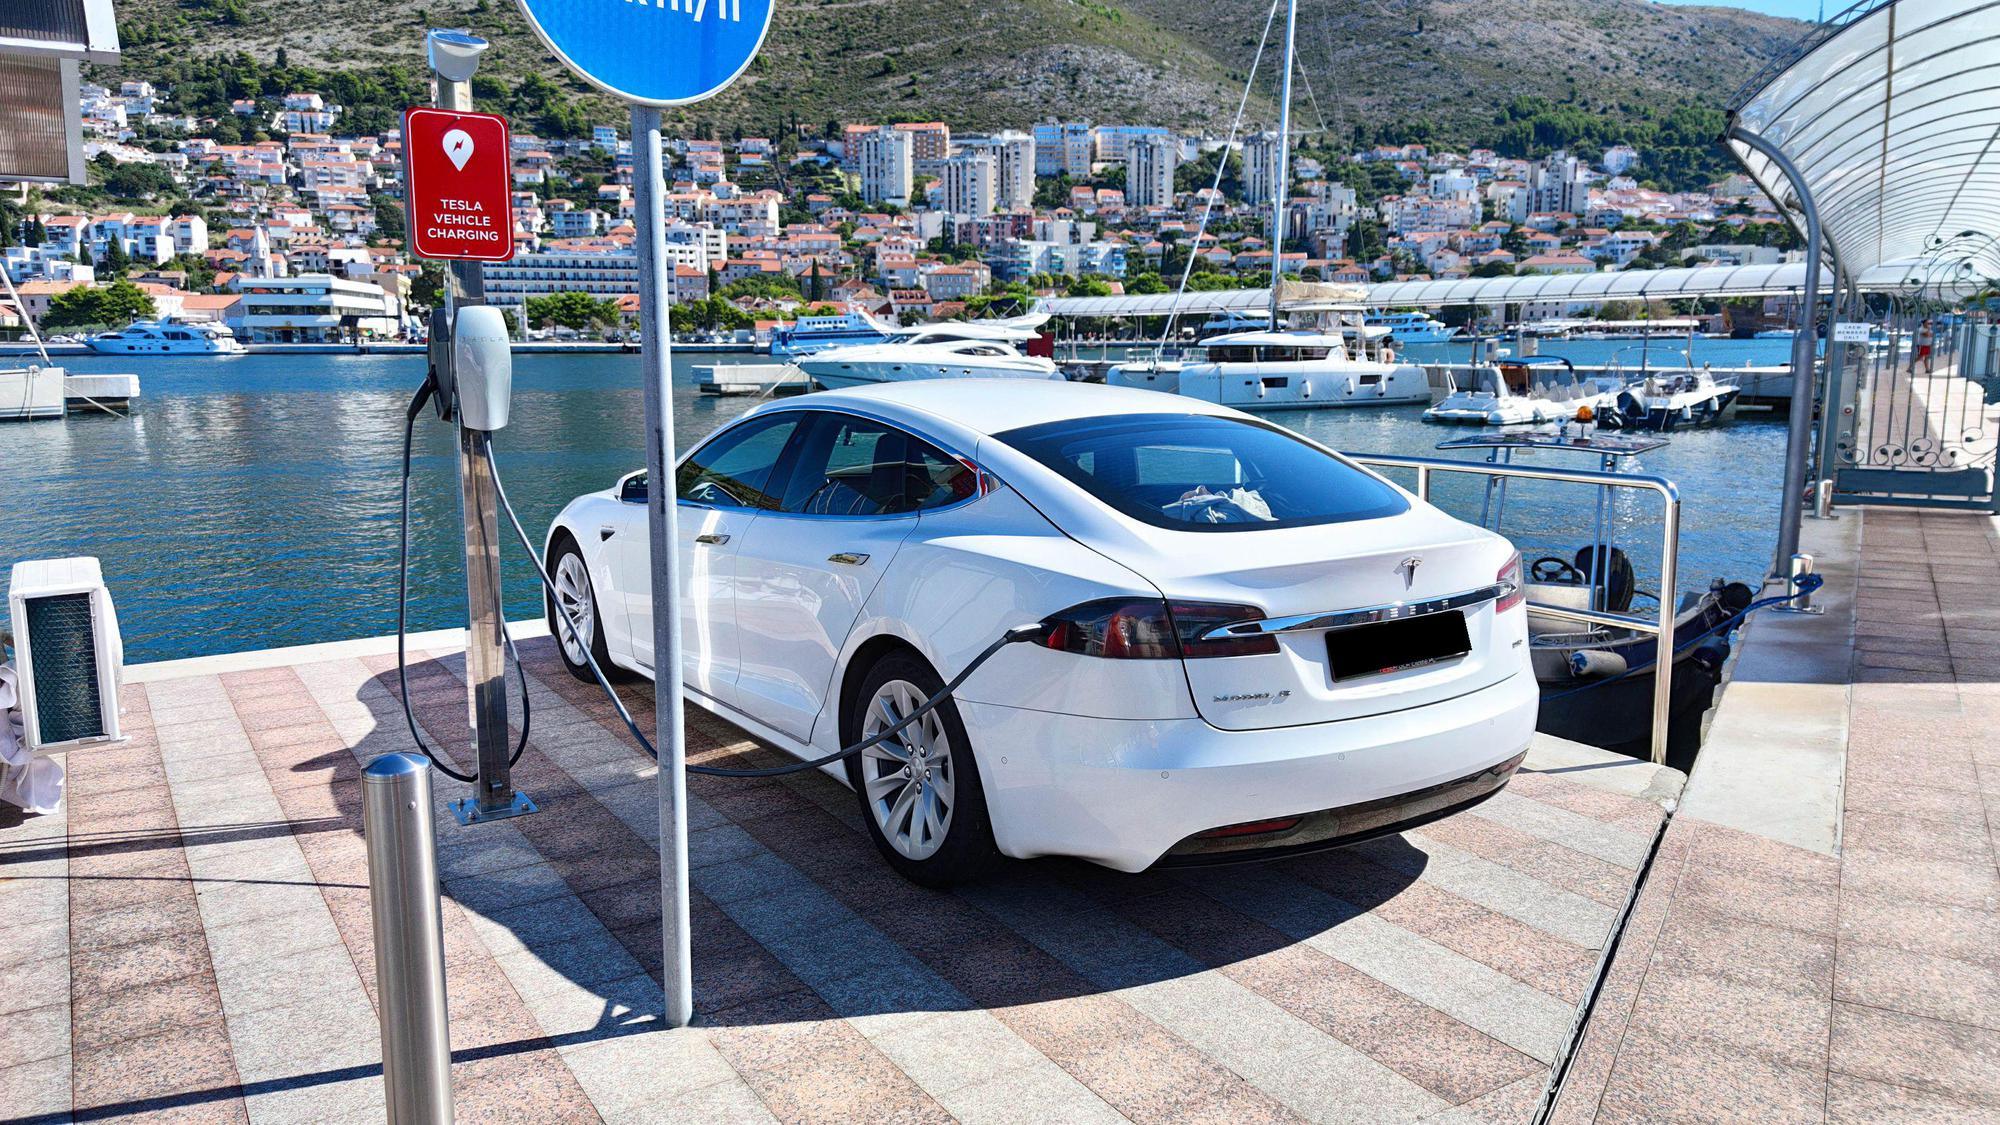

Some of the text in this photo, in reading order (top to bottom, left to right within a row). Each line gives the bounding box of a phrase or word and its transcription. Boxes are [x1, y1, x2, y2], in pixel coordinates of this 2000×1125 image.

[440, 199, 483, 212] TESLA
[433, 213, 491, 226] VEHICLE
[427, 227, 498, 241] CHARGING
